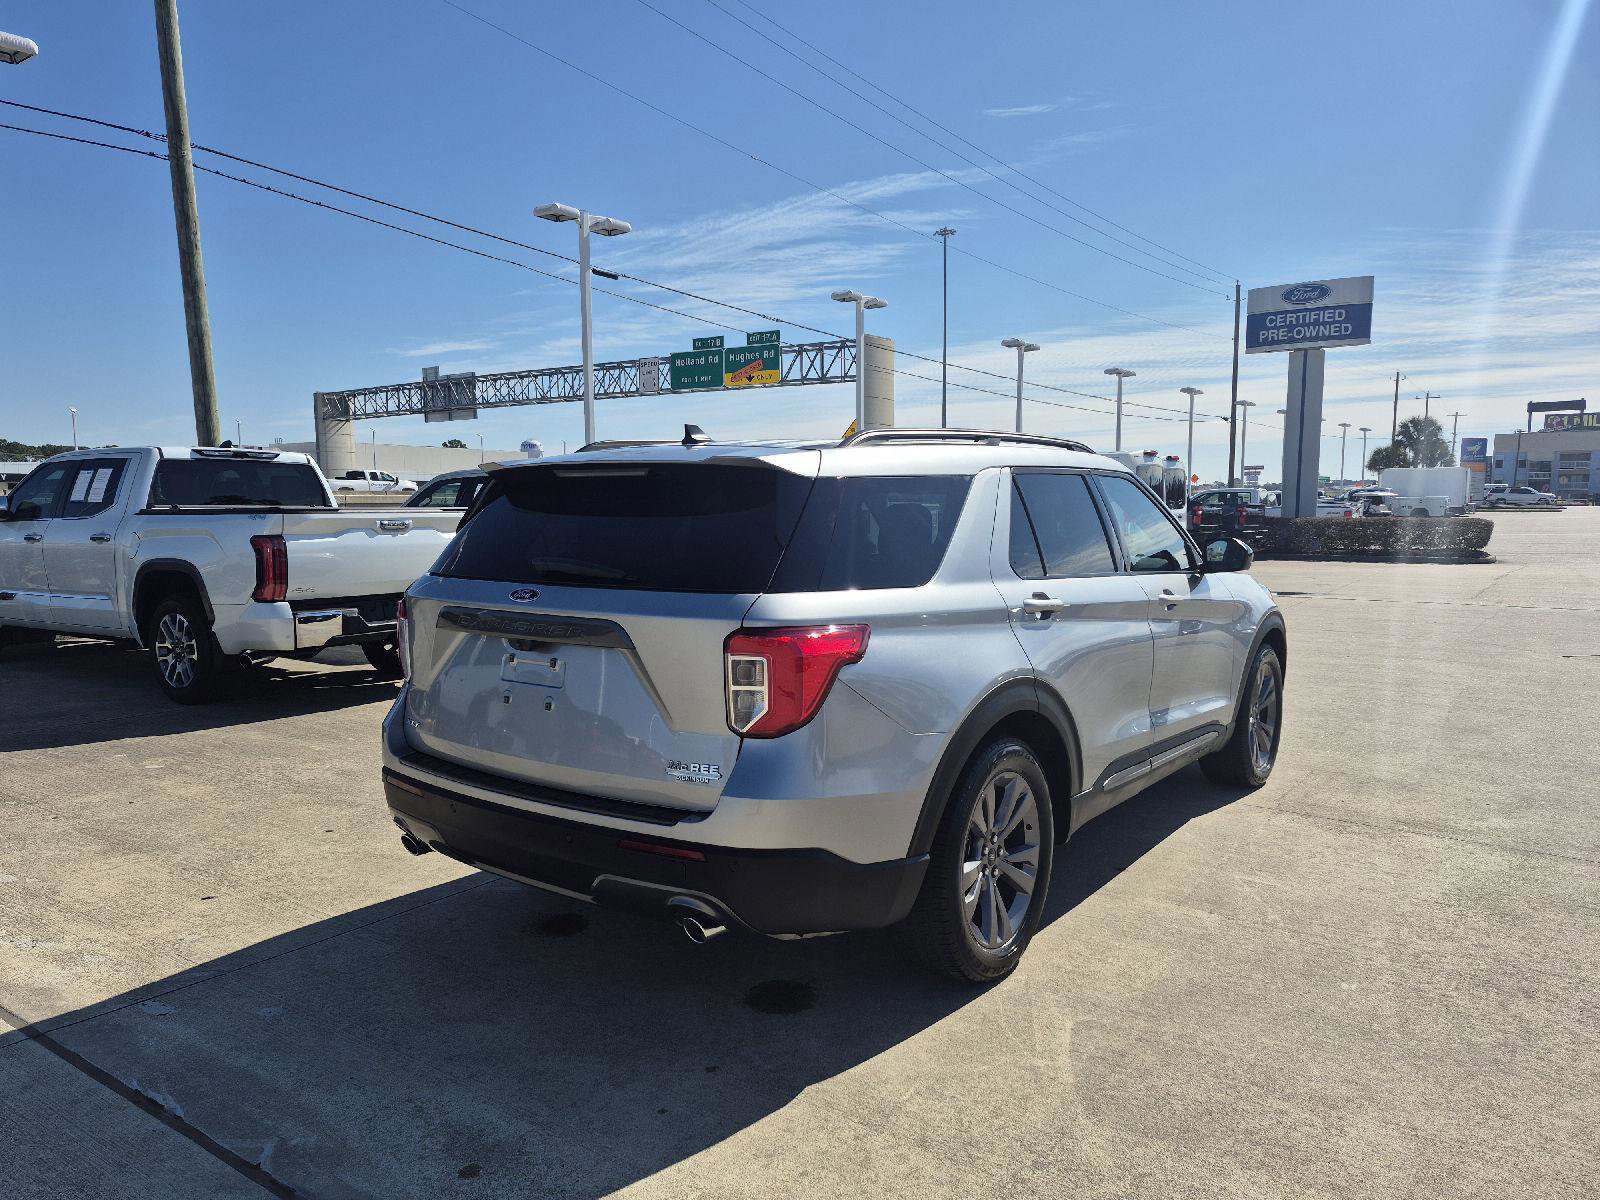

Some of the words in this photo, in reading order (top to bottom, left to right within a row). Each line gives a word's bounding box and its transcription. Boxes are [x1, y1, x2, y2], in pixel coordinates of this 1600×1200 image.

[1265, 309, 1346, 327] CERTIFIED
[1258, 323, 1353, 342] PRE-OWNED
[675, 355, 705, 367] Holland
[708, 354, 719, 364] Rd
[729, 351, 760, 363] Hughes
[763, 349, 775, 359] Rd
